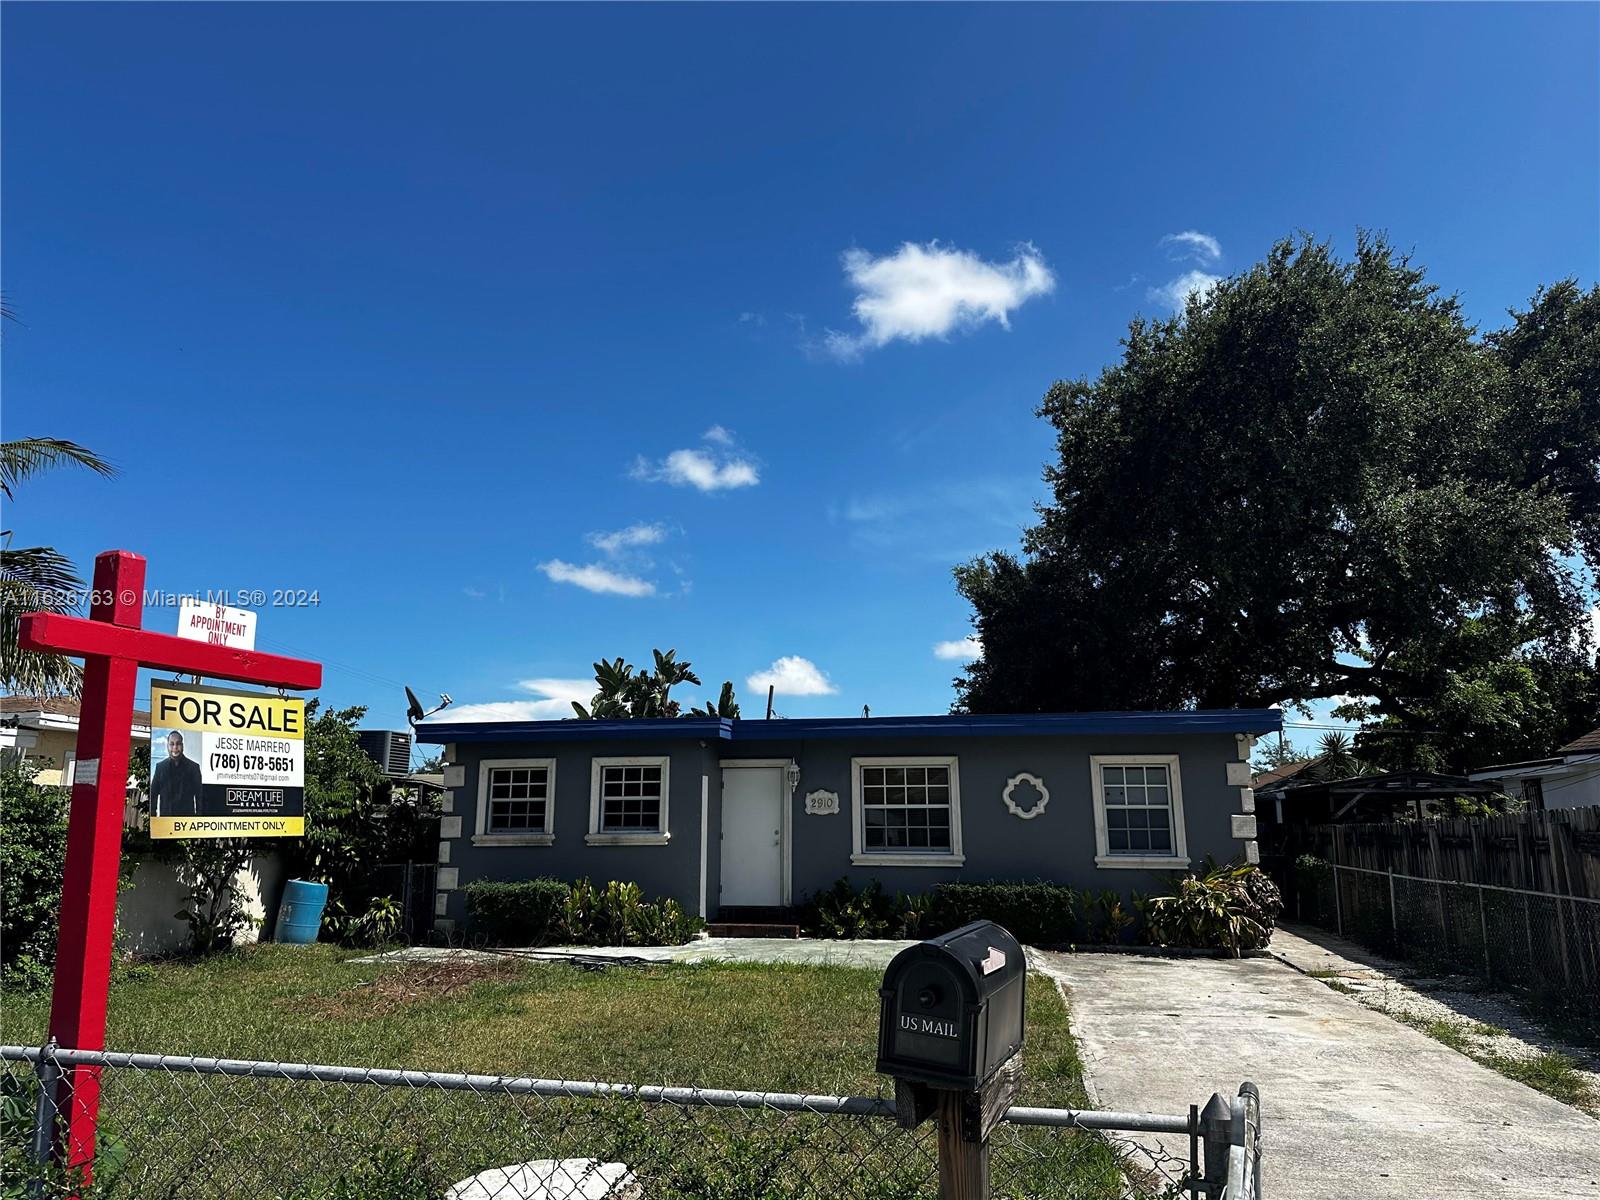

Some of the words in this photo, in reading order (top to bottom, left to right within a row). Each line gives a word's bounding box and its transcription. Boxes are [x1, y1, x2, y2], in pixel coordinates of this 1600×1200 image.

[215, 606, 226, 619] BY
[190, 614, 247, 637] APPOINTMENT
[207, 631, 229, 647] ONLY
[160, 694, 222, 727] FOR
[229, 702, 298, 733] SALE
[215, 737, 244, 751] JESSE
[246, 739, 291, 754] MARRERO
[210, 752, 240, 772] (786)
[243, 755, 294, 772] 678-5651
[228, 790, 263, 802] DREAM
[264, 791, 282, 803] LIFE
[811, 798, 833, 808] 2910
[174, 821, 186, 831] BY
[189, 821, 261, 831] APPOINTMENT
[262, 821, 286, 831] ONLY
[901, 1016, 918, 1031] US
[921, 1019, 958, 1038] MAIL
